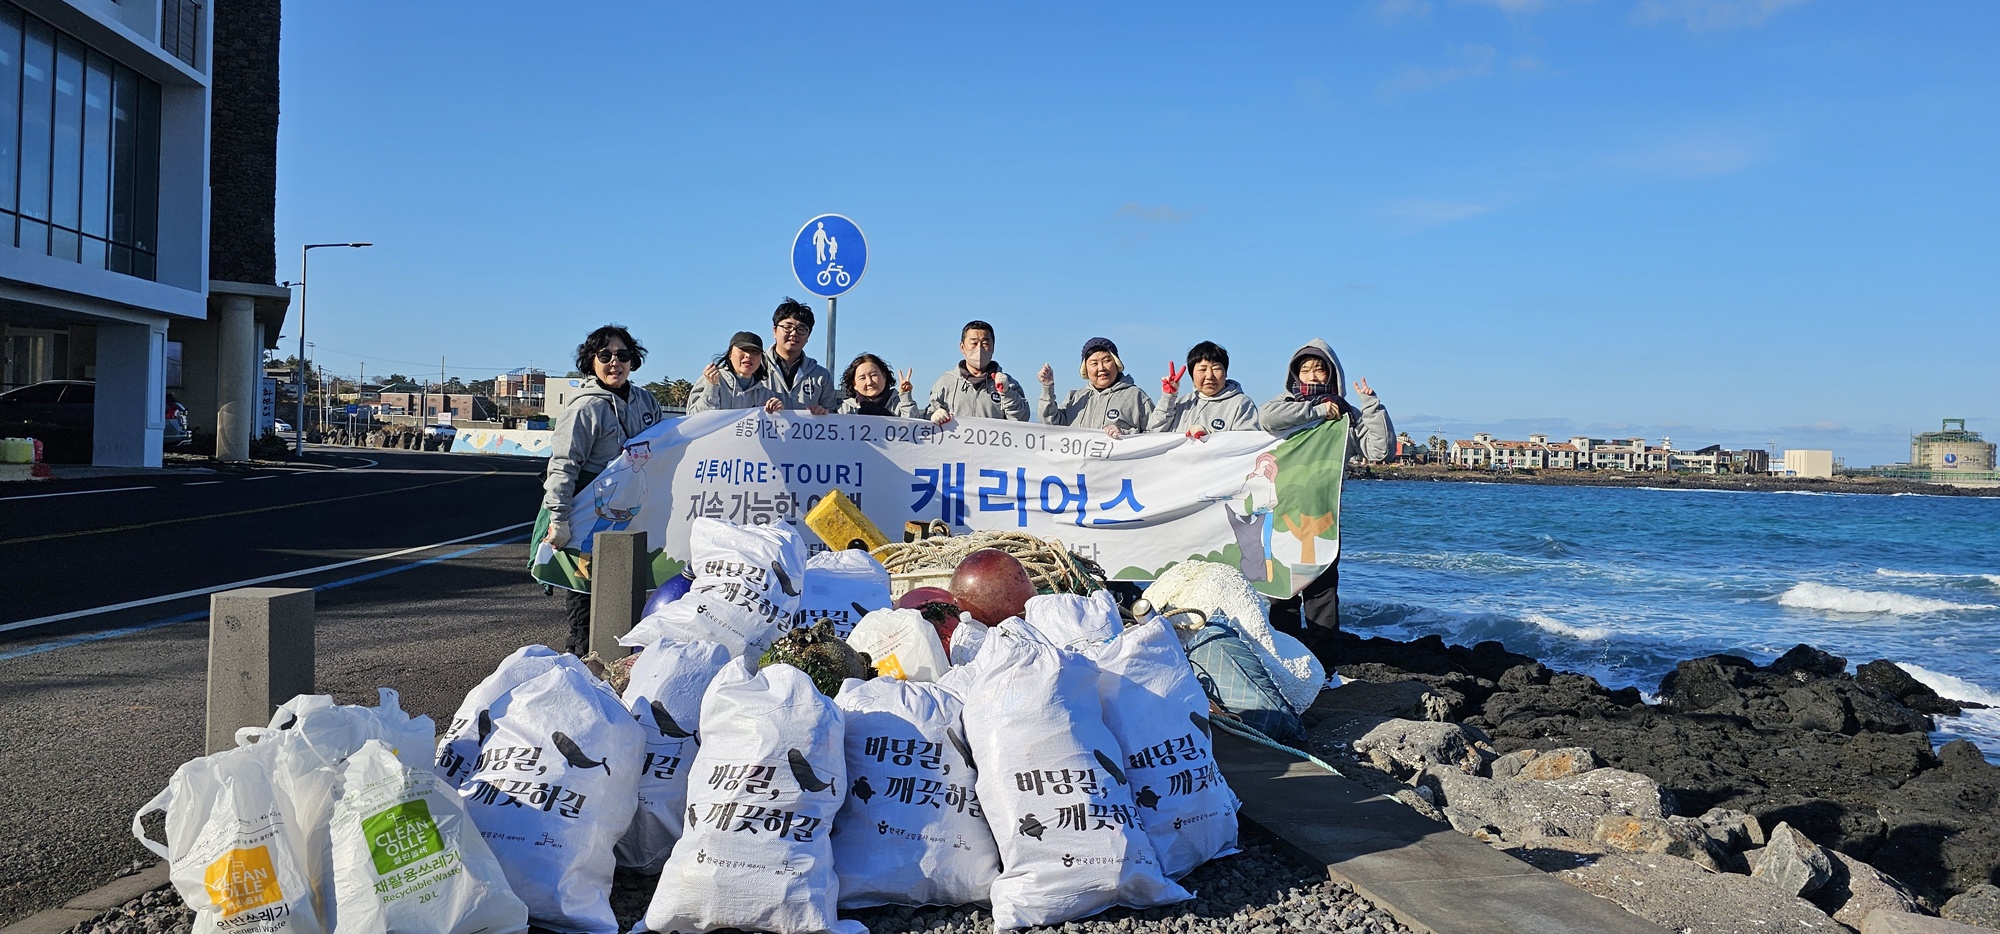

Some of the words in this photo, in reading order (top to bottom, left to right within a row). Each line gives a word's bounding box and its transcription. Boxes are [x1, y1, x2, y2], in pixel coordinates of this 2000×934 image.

[1060, 437, 1114, 459] 30(금)
[695, 459, 863, 487] 리투어[RE:TOUR]
[686, 490, 725, 522] 지속
[730, 491, 800, 526] 가능한
[910, 463, 1145, 528] 캐리어스
[705, 559, 769, 592] 바당길,
[716, 582, 792, 633] 깨끗하길
[473, 746, 548, 776] 바당길,
[865, 736, 951, 775] 바당길,
[1128, 733, 1206, 769] 바당길,
[469, 778, 587, 819] 깨끗하길
[708, 764, 780, 801] 바당길,
[1014, 768, 1108, 799] 바당길,
[375, 819, 430, 847] CLEAN
[703, 802, 822, 843] 깨끗하길
[385, 831, 428, 857] OLLE
[213, 867, 268, 891] CLEAN
[373, 850, 461, 895] 재활용쓰레기
[383, 878, 433, 904] Recyclable
[434, 866, 461, 882] Waste
[221, 880, 264, 900] OLLE
[418, 893, 431, 904] 20
[432, 890, 439, 898] L
[217, 903, 290, 931] 일반쓰레기
[262, 920, 286, 933] Waste
